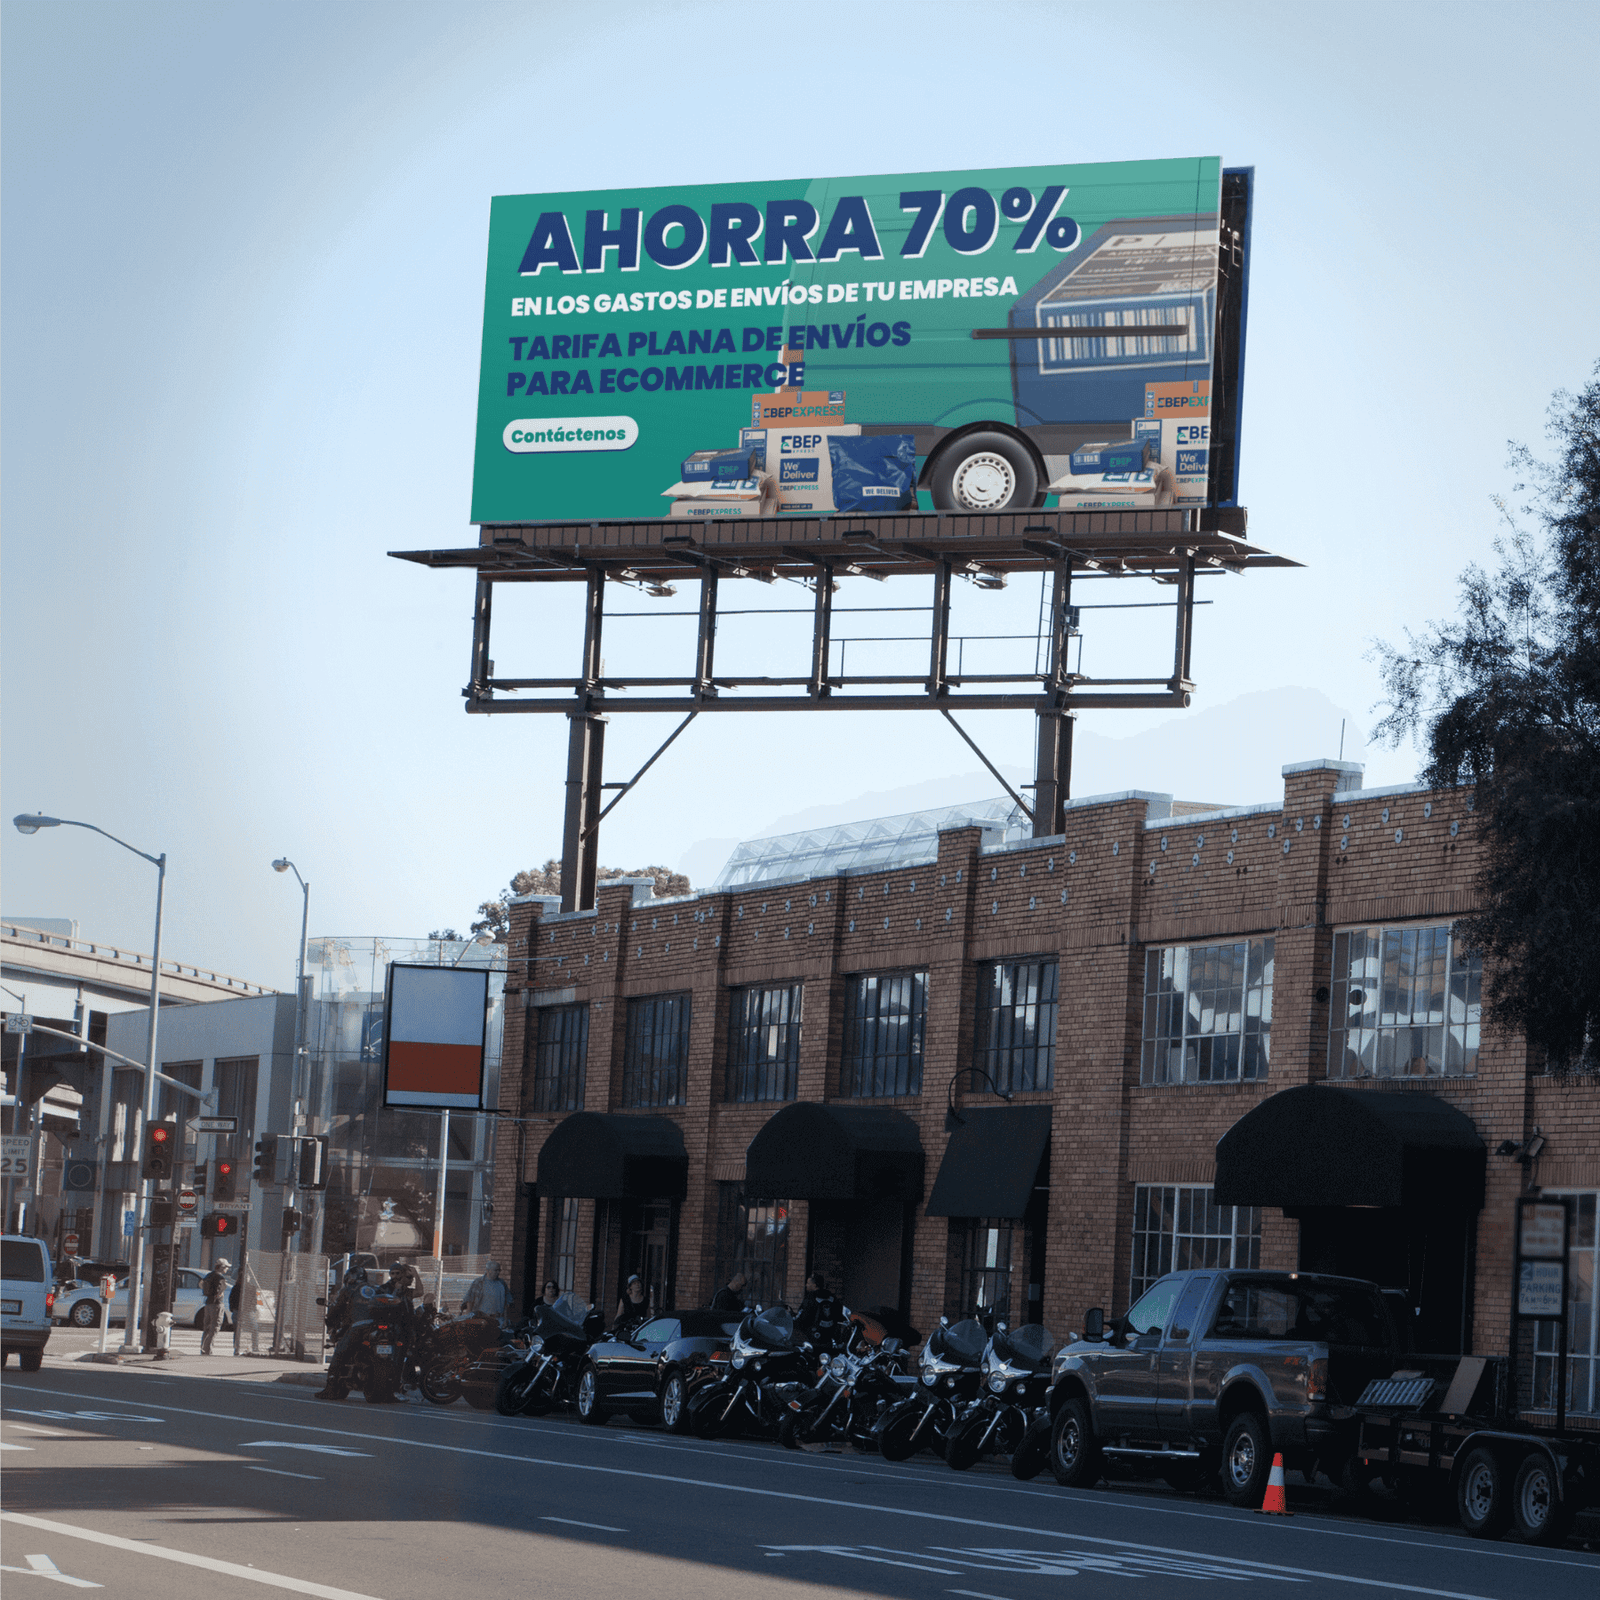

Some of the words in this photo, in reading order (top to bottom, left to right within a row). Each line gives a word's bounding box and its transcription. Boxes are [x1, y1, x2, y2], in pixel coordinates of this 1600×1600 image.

[517, 195, 885, 277] AHORRA
[899, 185, 1082, 260] 70%
[511, 297, 542, 317] EN
[545, 295, 590, 316] LOS
[593, 290, 692, 313] GASTOS
[696, 288, 729, 309] DE
[730, 279, 822, 307] ENVÍOS
[827, 284, 858, 303] DE
[863, 282, 895, 301] TU
[899, 276, 1019, 300] EMPRESA
[509, 333, 622, 361] TARIFA
[627, 328, 737, 357] PLANA
[742, 326, 784, 352] DE
[787, 313, 912, 351] ENVÍOS
[506, 369, 594, 397] PARA
[599, 361, 806, 394] ECOMMERCE
[511, 426, 626, 444] Contáctenos
[783, 462, 799, 471] We
[783, 471, 816, 480] Deliver
[201, 1120, 214, 1128] ONE
[217, 1120, 232, 1128] WAY
[2, 1138, 30, 1147] SPEED
[3, 1148, 26, 1156] LIMIT
[2, 1158, 27, 1174] 25
[1519, 1283, 1561, 1294] PARKING
